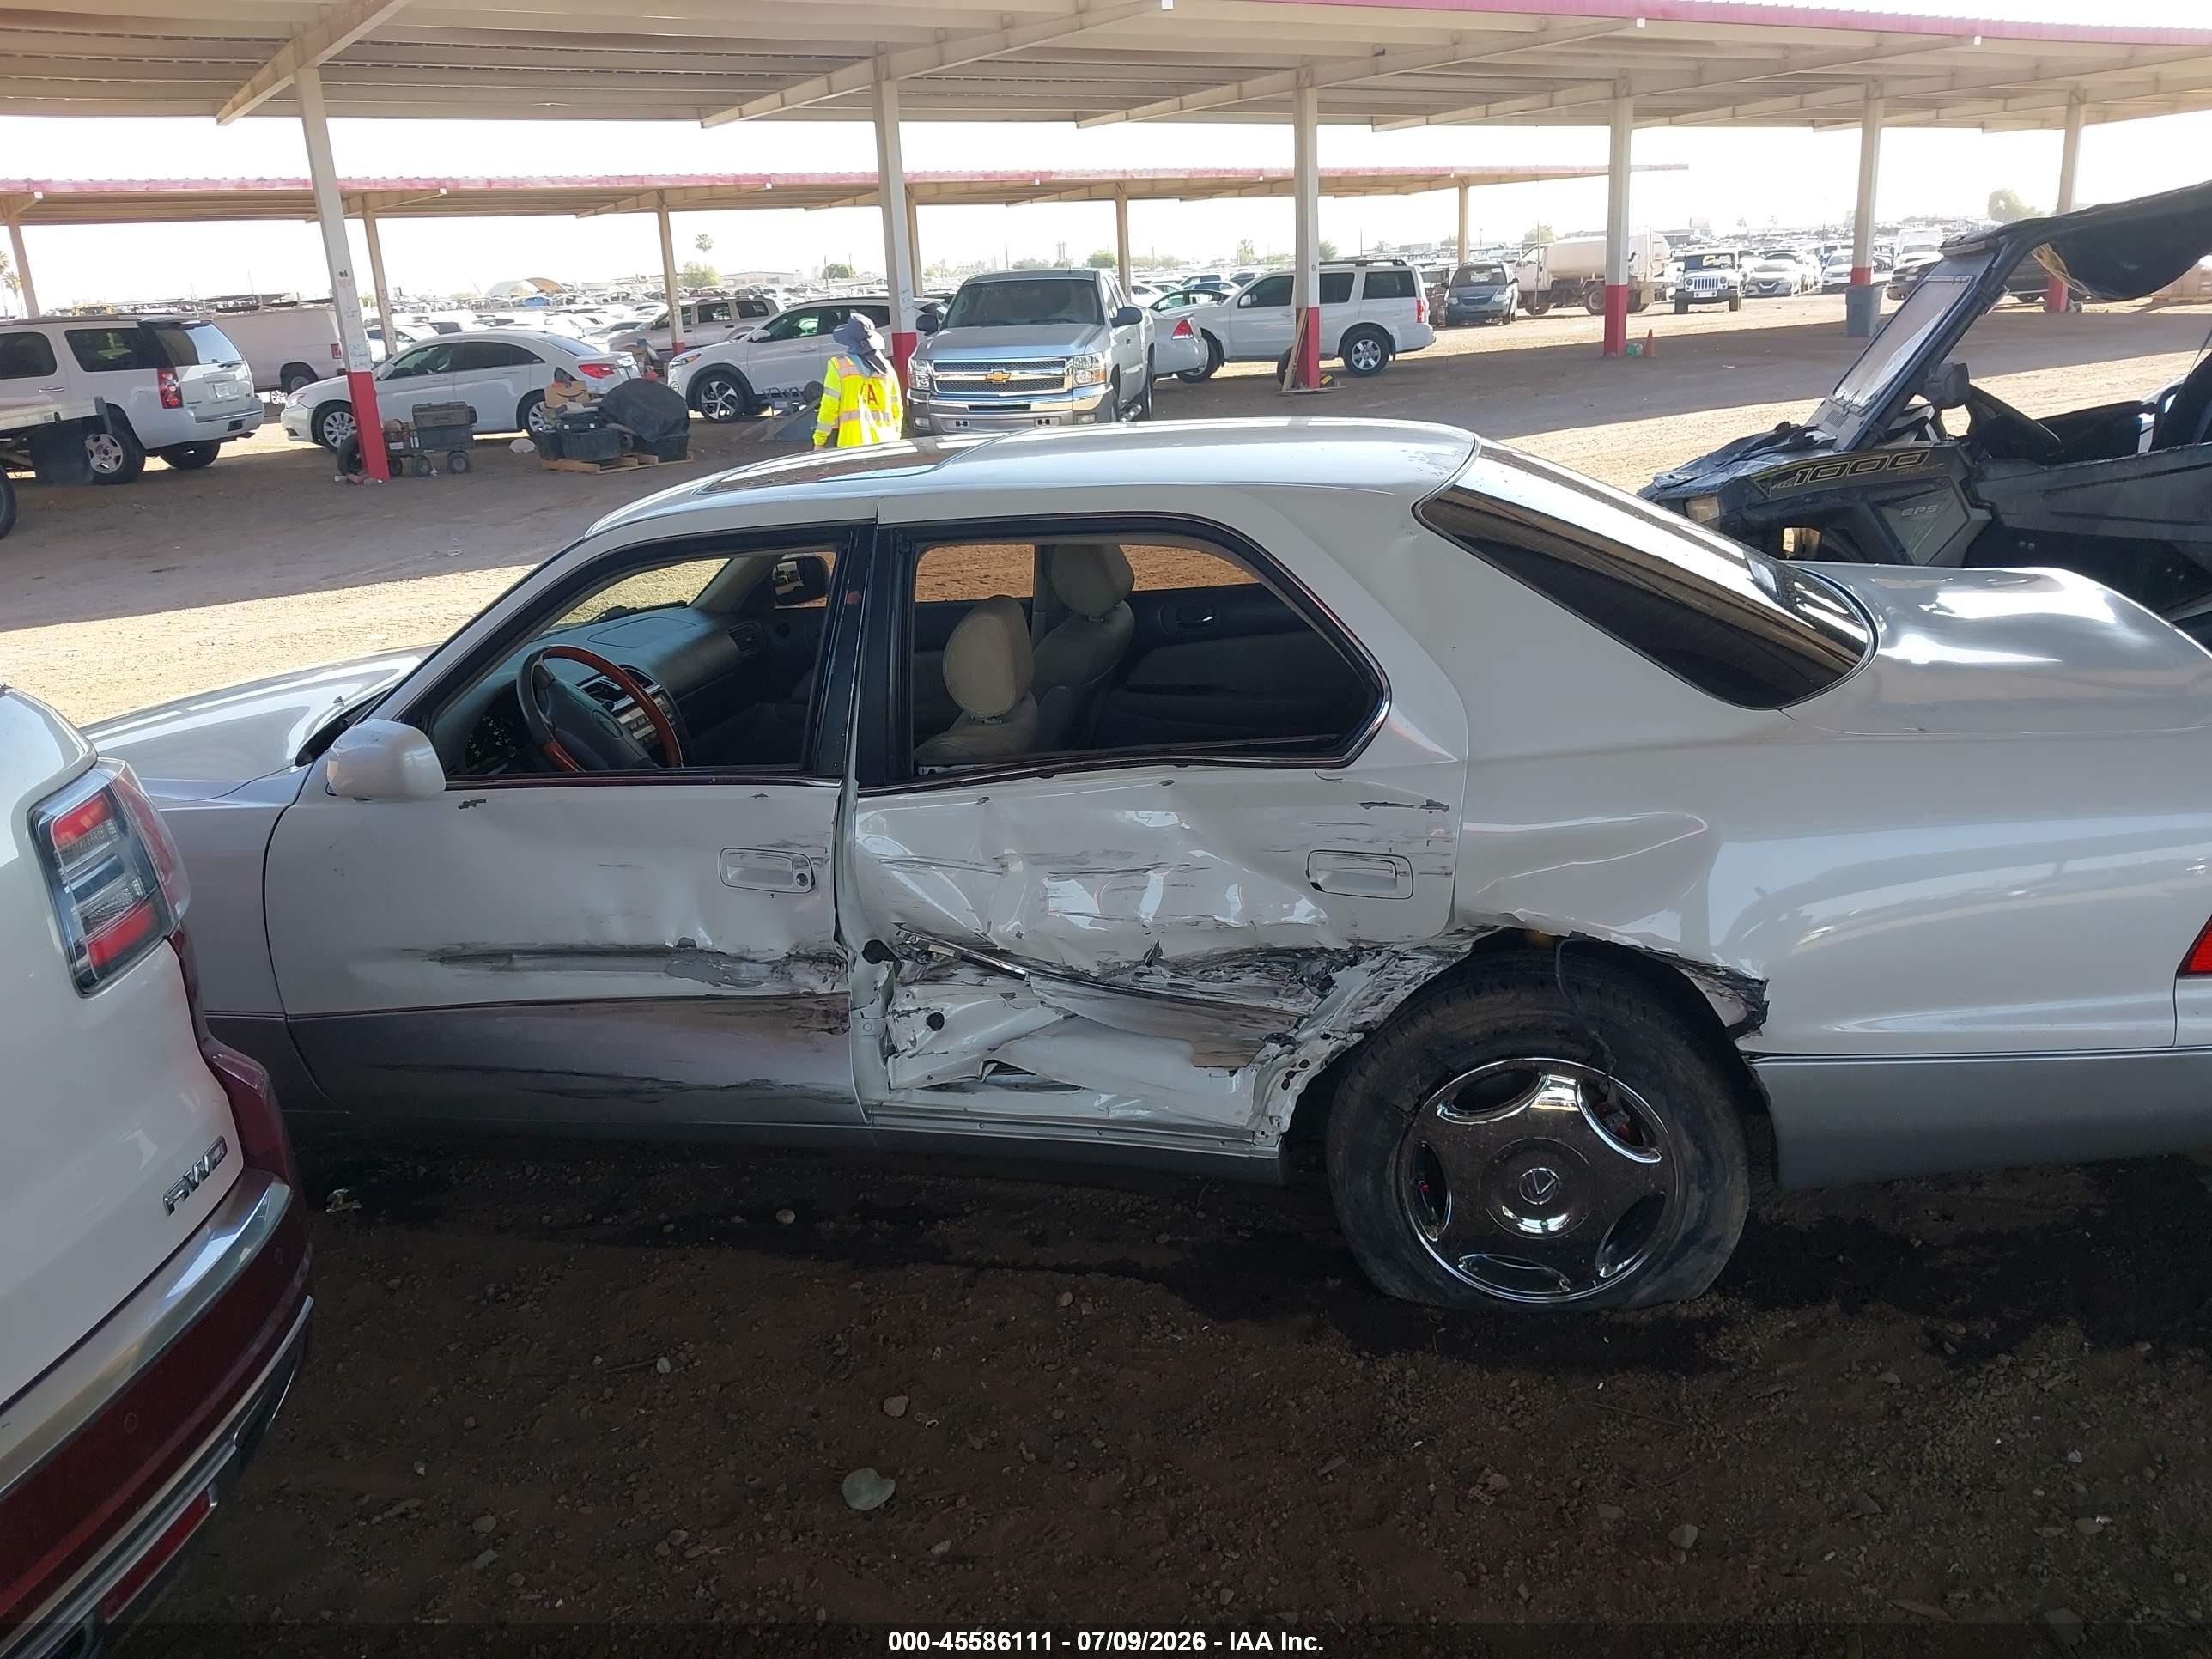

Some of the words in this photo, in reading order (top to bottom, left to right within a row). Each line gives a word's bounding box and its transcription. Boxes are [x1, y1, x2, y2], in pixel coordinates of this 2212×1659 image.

[1792, 449, 1931, 486] 1000
[1901, 504, 1938, 517] EPS
[163, 1135, 228, 1216] FWD
